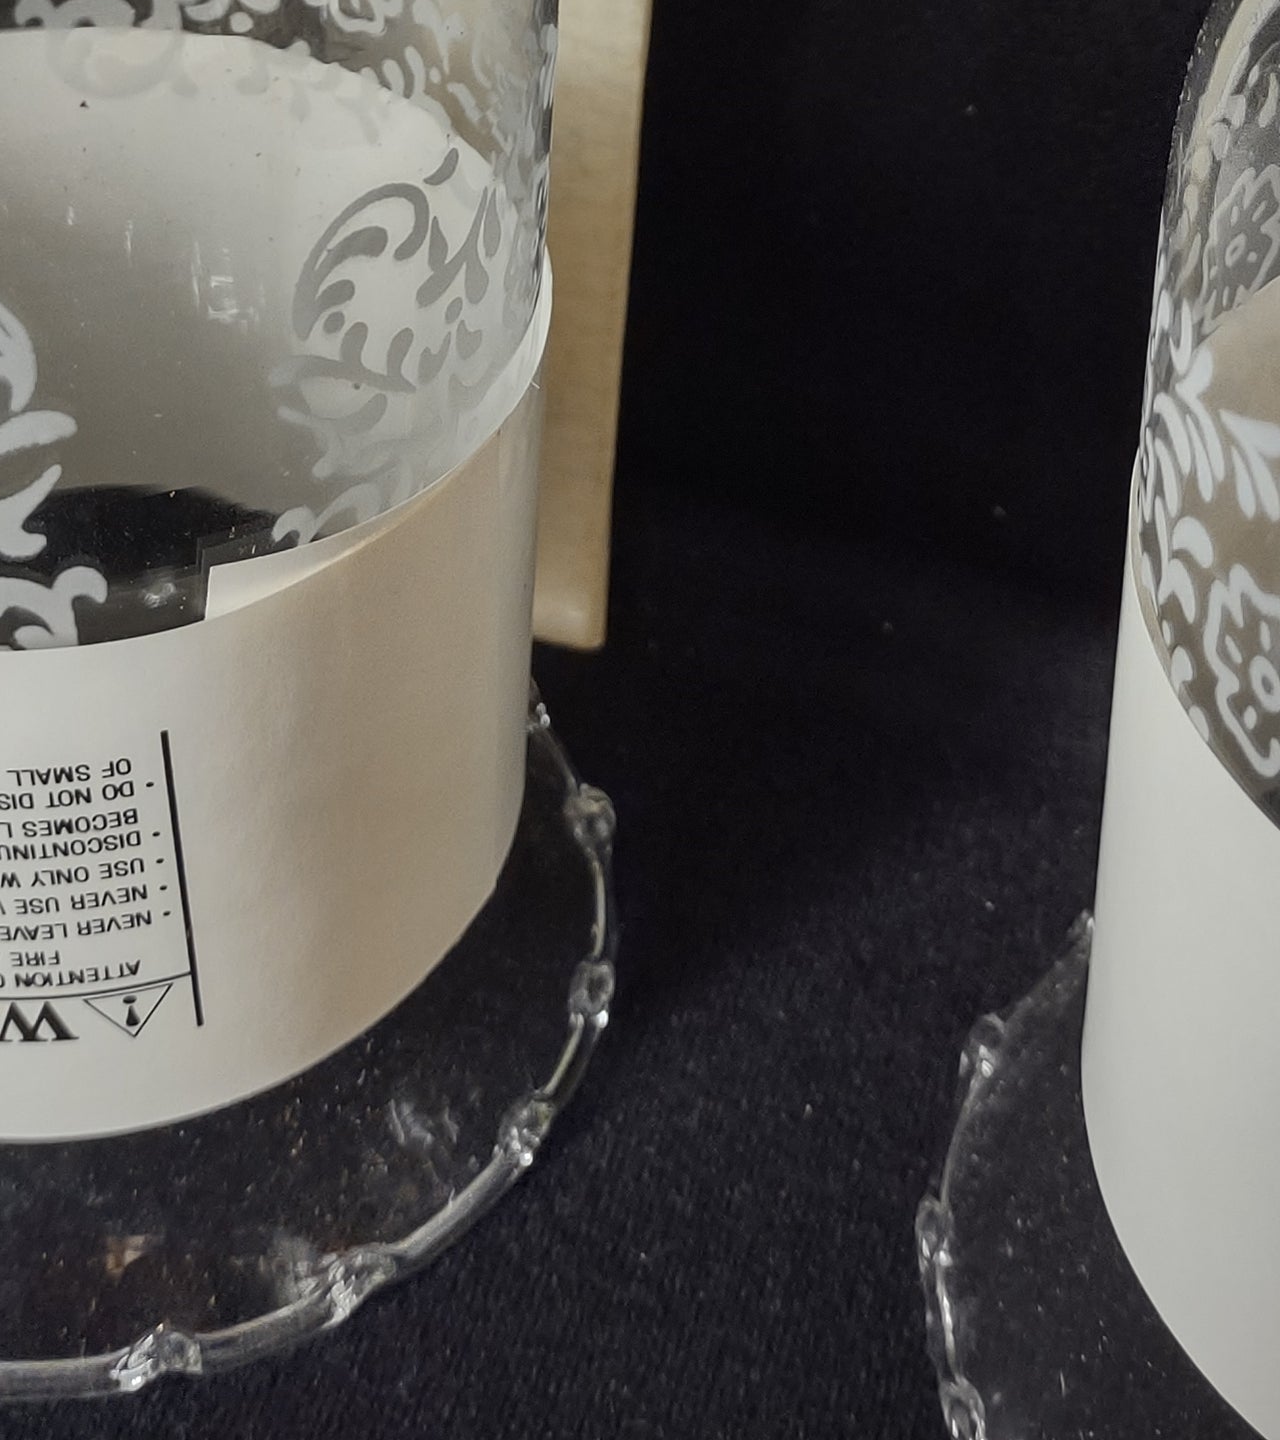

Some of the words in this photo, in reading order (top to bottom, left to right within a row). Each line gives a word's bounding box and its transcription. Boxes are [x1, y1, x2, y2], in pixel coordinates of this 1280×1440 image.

[6, 764, 91, 788] SMALL
[100, 757, 132, 779] OF
[44, 787, 92, 809] NOT
[101, 780, 135, 801] DO
[21, 807, 139, 838] BECOMES
[30, 866, 90, 887] ONLY
[98, 857, 145, 880] USE
[13, 897, 59, 915] USE
[70, 884, 148, 911] NEVER
[76, 910, 152, 936] NEVER
[10, 950, 60, 967] FIRE
[15, 959, 141, 988] ATTENTION
